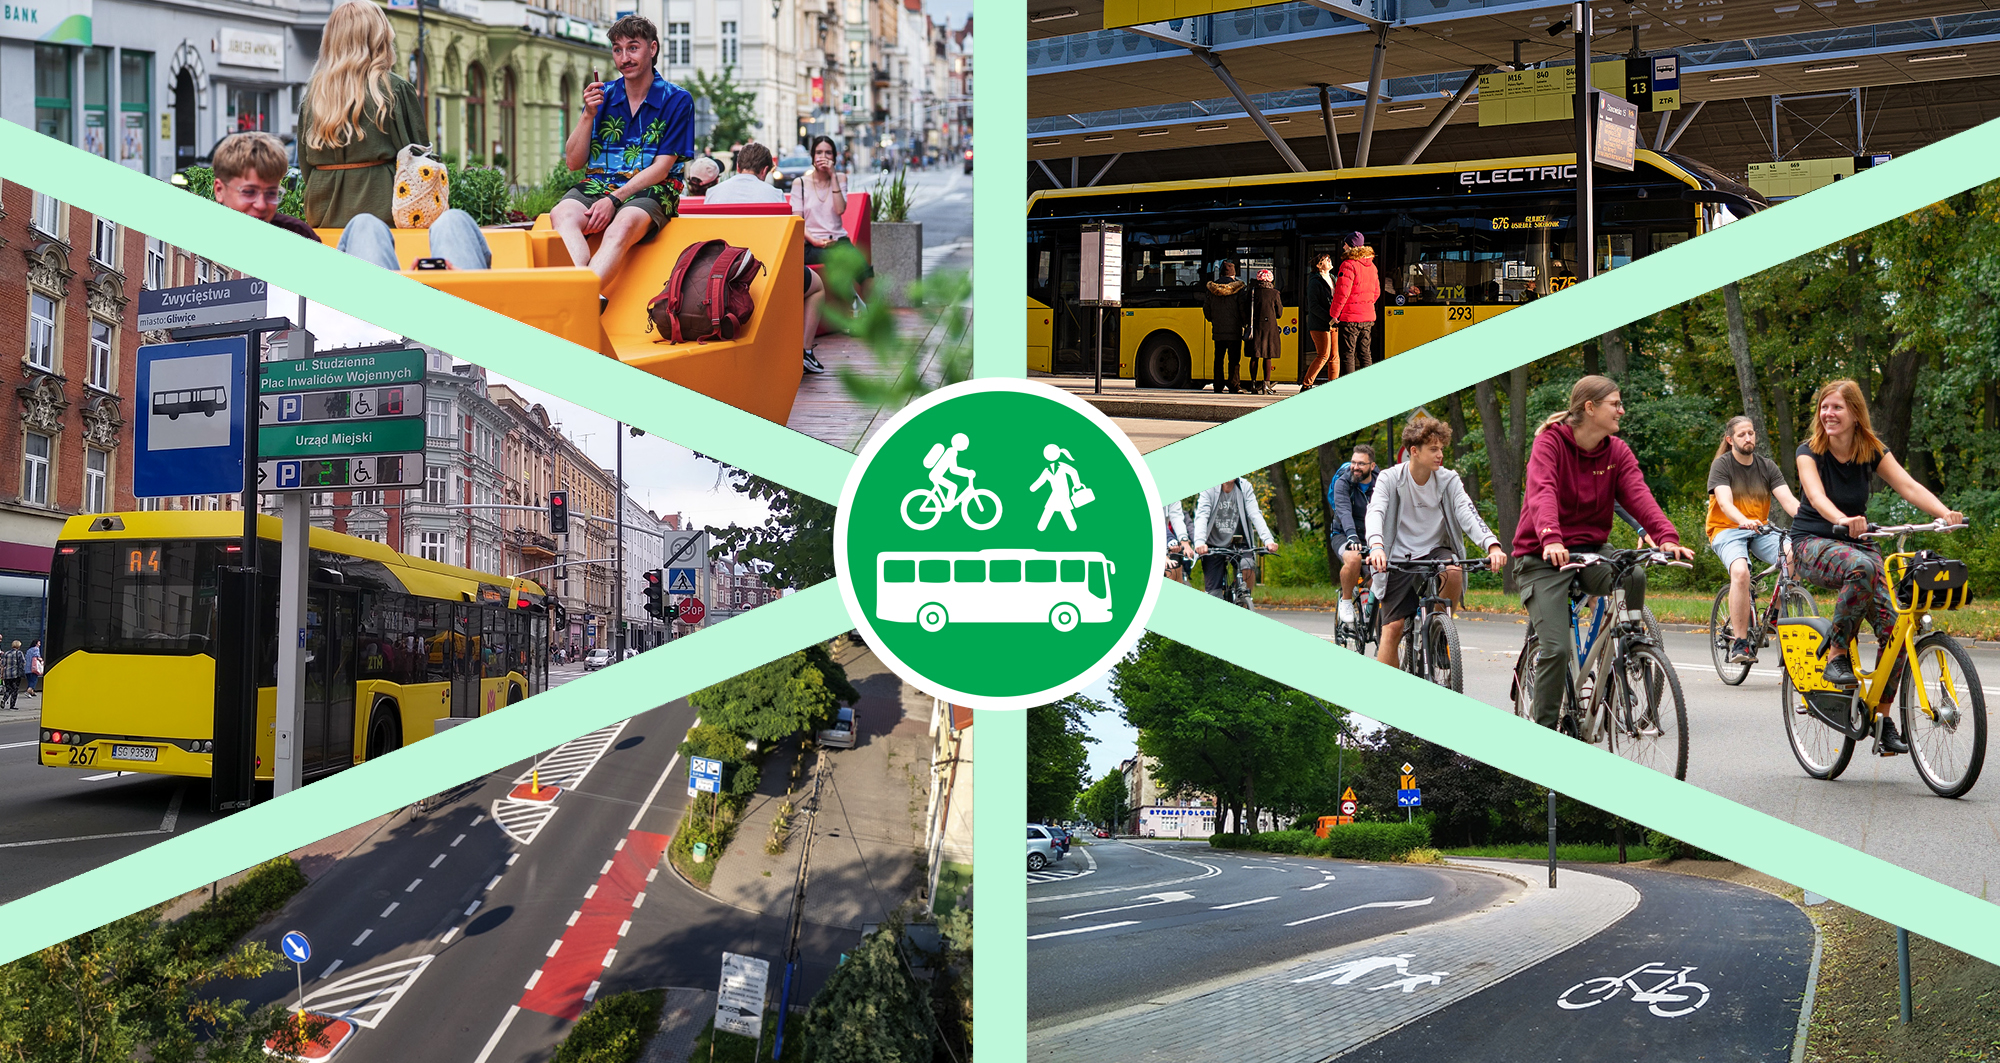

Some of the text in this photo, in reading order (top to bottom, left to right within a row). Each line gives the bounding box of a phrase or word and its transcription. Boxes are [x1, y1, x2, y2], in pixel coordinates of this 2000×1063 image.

[5, 5, 38, 23] BANK
[1508, 74, 1522, 82] M16
[1536, 71, 1549, 79] 840
[1566, 68, 1576, 76] 84
[1480, 77, 1490, 85] M1
[1632, 82, 1647, 95] 13
[1460, 165, 1577, 185] ELECTRIC
[1492, 217, 1509, 230] 676
[161, 281, 265, 307] Zwycięstwa 02
[1436, 284, 1465, 299] ZTM
[1448, 306, 1472, 321] 293
[295, 356, 376, 372] ul. Studzienna
[261, 367, 412, 389] Plac Inwalidów Wojennych
[295, 431, 373, 448] Urząd Miejski
[130, 550, 159, 572] A 4
[680, 606, 703, 616] STOP
[368, 655, 383, 670] ZTM
[69, 747, 98, 765] 267
[117, 747, 155, 758] SG 9358X
